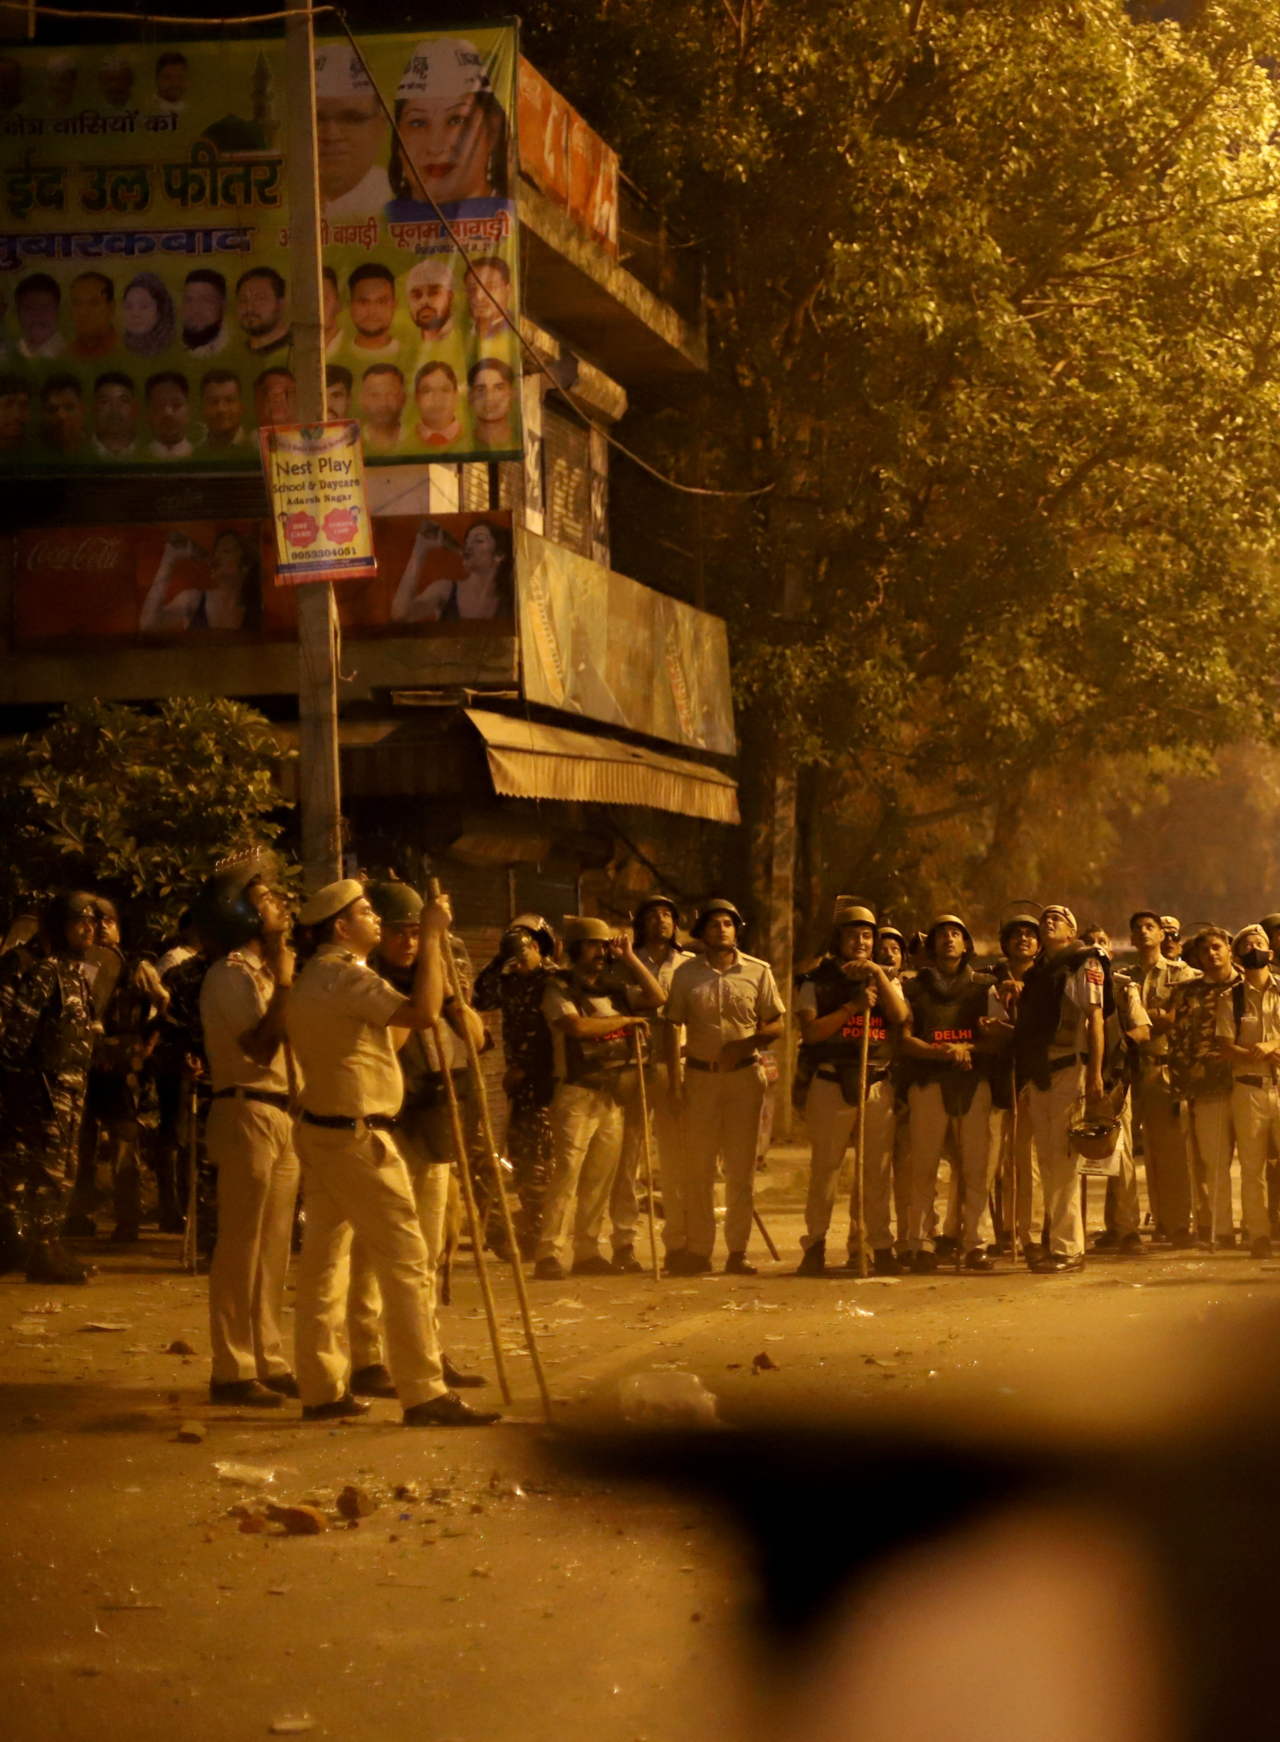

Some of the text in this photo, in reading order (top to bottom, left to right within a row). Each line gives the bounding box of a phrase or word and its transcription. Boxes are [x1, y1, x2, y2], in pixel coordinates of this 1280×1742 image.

[53, 109, 140, 134] वासियों
[145, 112, 180, 131] को
[5, 140, 284, 220] ईद उल फीतर
[390, 223, 440, 248] पूनम
[275, 457, 352, 477] Nest Play
[272, 478, 360, 494] School & Daycare
[287, 493, 352, 505] Adarsh Nagar
[847, 1015, 883, 1027] DEHI
[934, 1028, 972, 1041] DELHI
